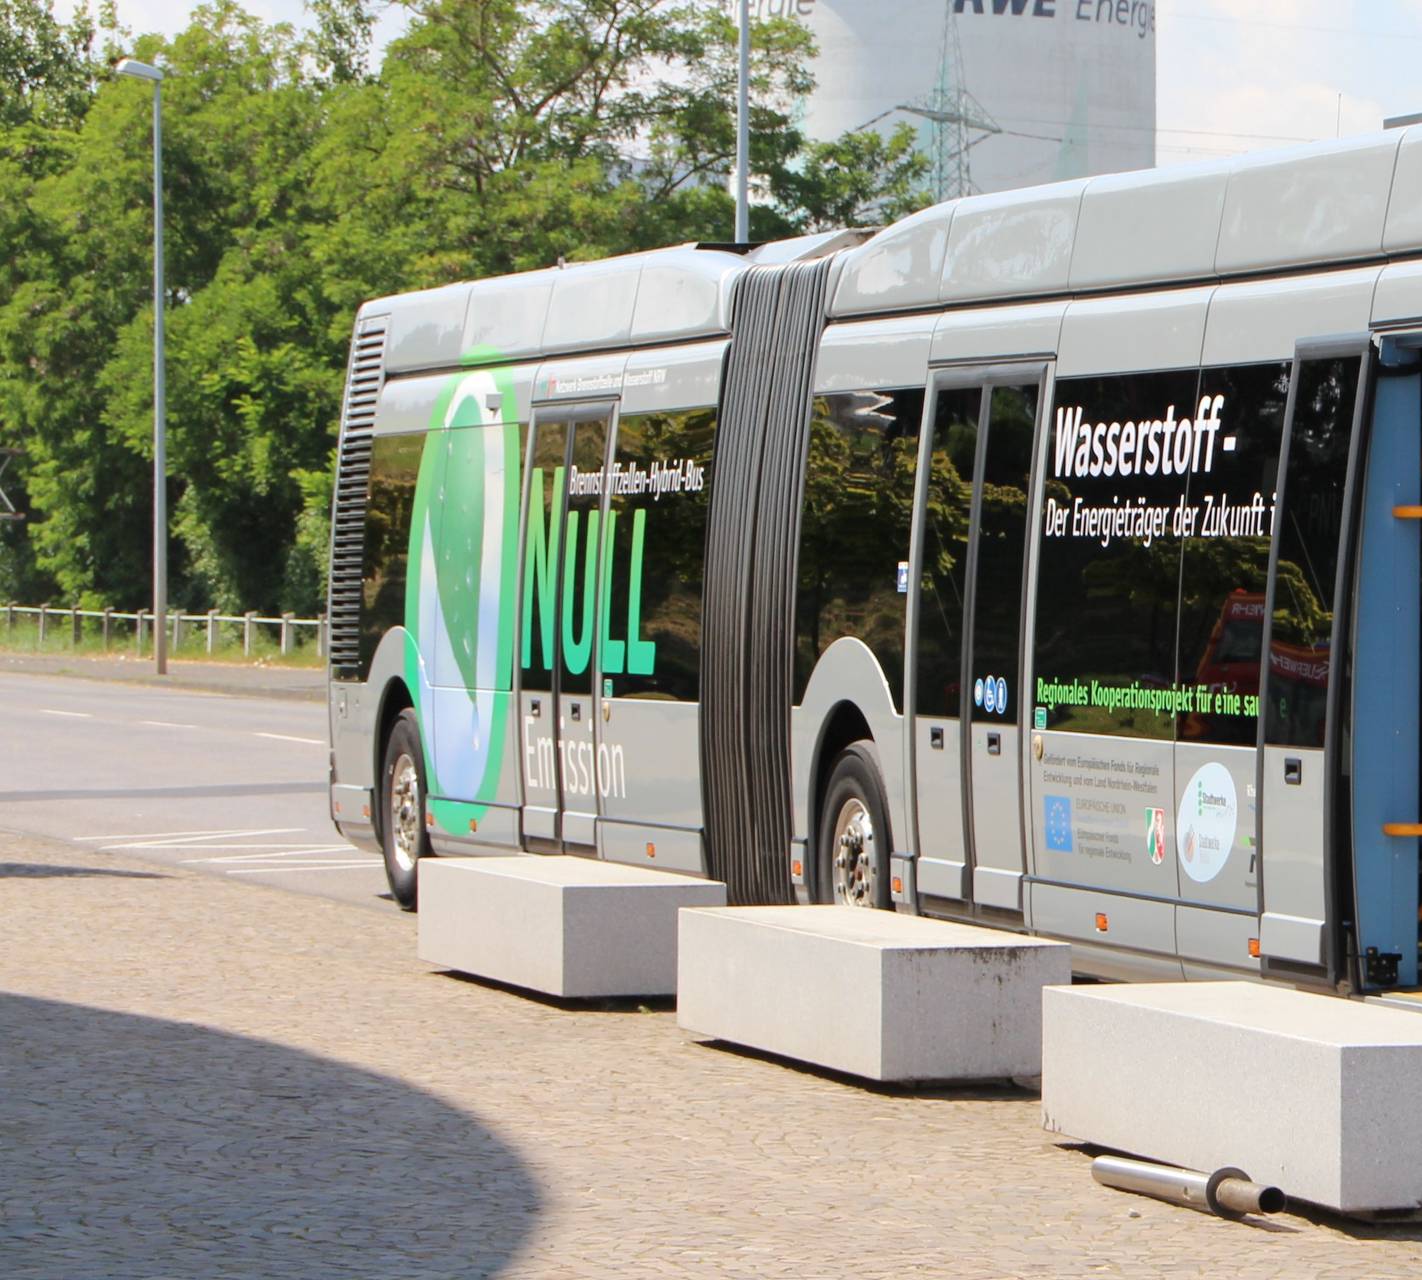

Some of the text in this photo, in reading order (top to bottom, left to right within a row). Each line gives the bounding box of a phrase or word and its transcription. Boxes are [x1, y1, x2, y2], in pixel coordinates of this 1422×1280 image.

[1046, 497, 1070, 537] Der
[1072, 495, 1170, 548] Energieträger
[1173, 494, 1199, 537] der
[1201, 491, 1266, 537] Zukunft
[521, 466, 656, 675] NULL
[1037, 677, 1088, 710] Regionales
[1091, 679, 1193, 718] Kooperationsprojekt
[1196, 684, 1213, 714] für
[523, 716, 626, 799] Emission
